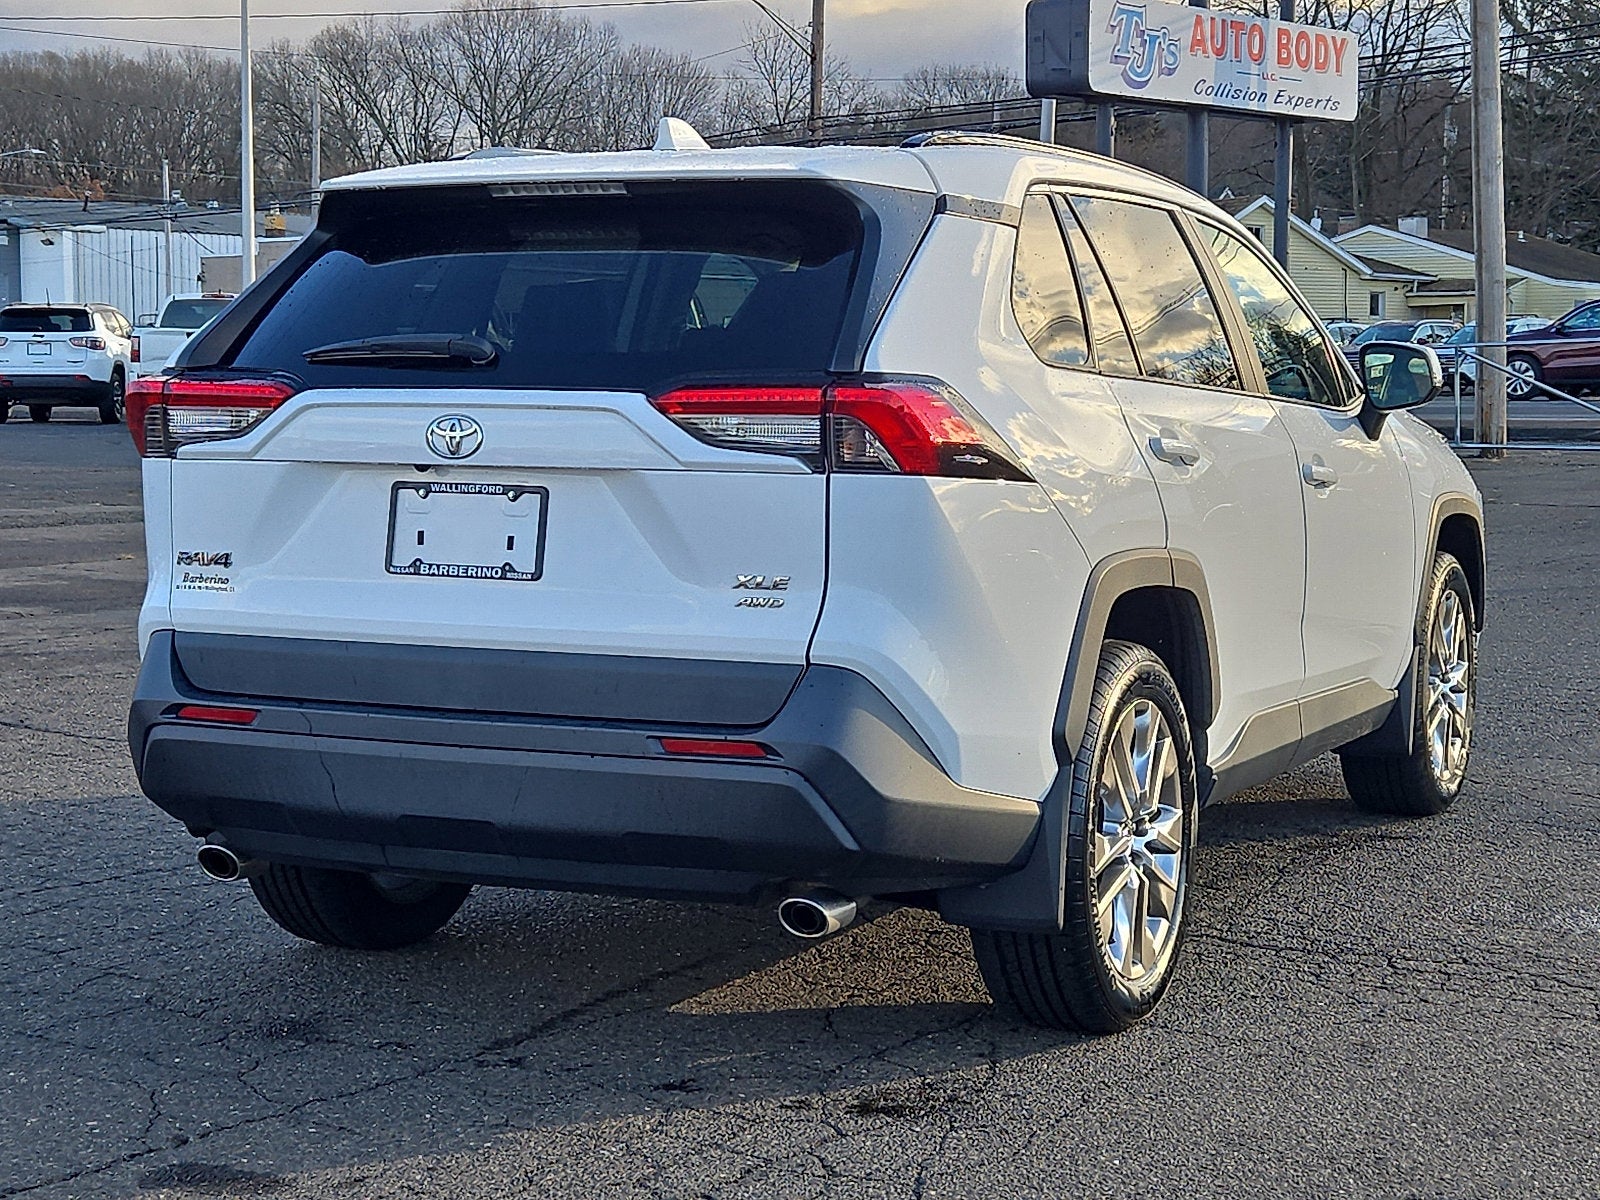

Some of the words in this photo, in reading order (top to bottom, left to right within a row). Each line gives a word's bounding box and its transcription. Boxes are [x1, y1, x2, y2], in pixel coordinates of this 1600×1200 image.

[1105, 1, 1181, 89] TJ's
[1189, 14, 1266, 64] AUTO
[1277, 27, 1349, 76] BODY
[1193, 78, 1268, 103] Collision
[1273, 89, 1341, 111] Experts
[430, 483, 504, 494] WALLINGFORD
[176, 551, 234, 569] RAV4
[182, 572, 230, 585] Barberino
[420, 564, 502, 579] BARBERINO
[731, 574, 791, 591] XLE
[734, 596, 785, 608] AWD
